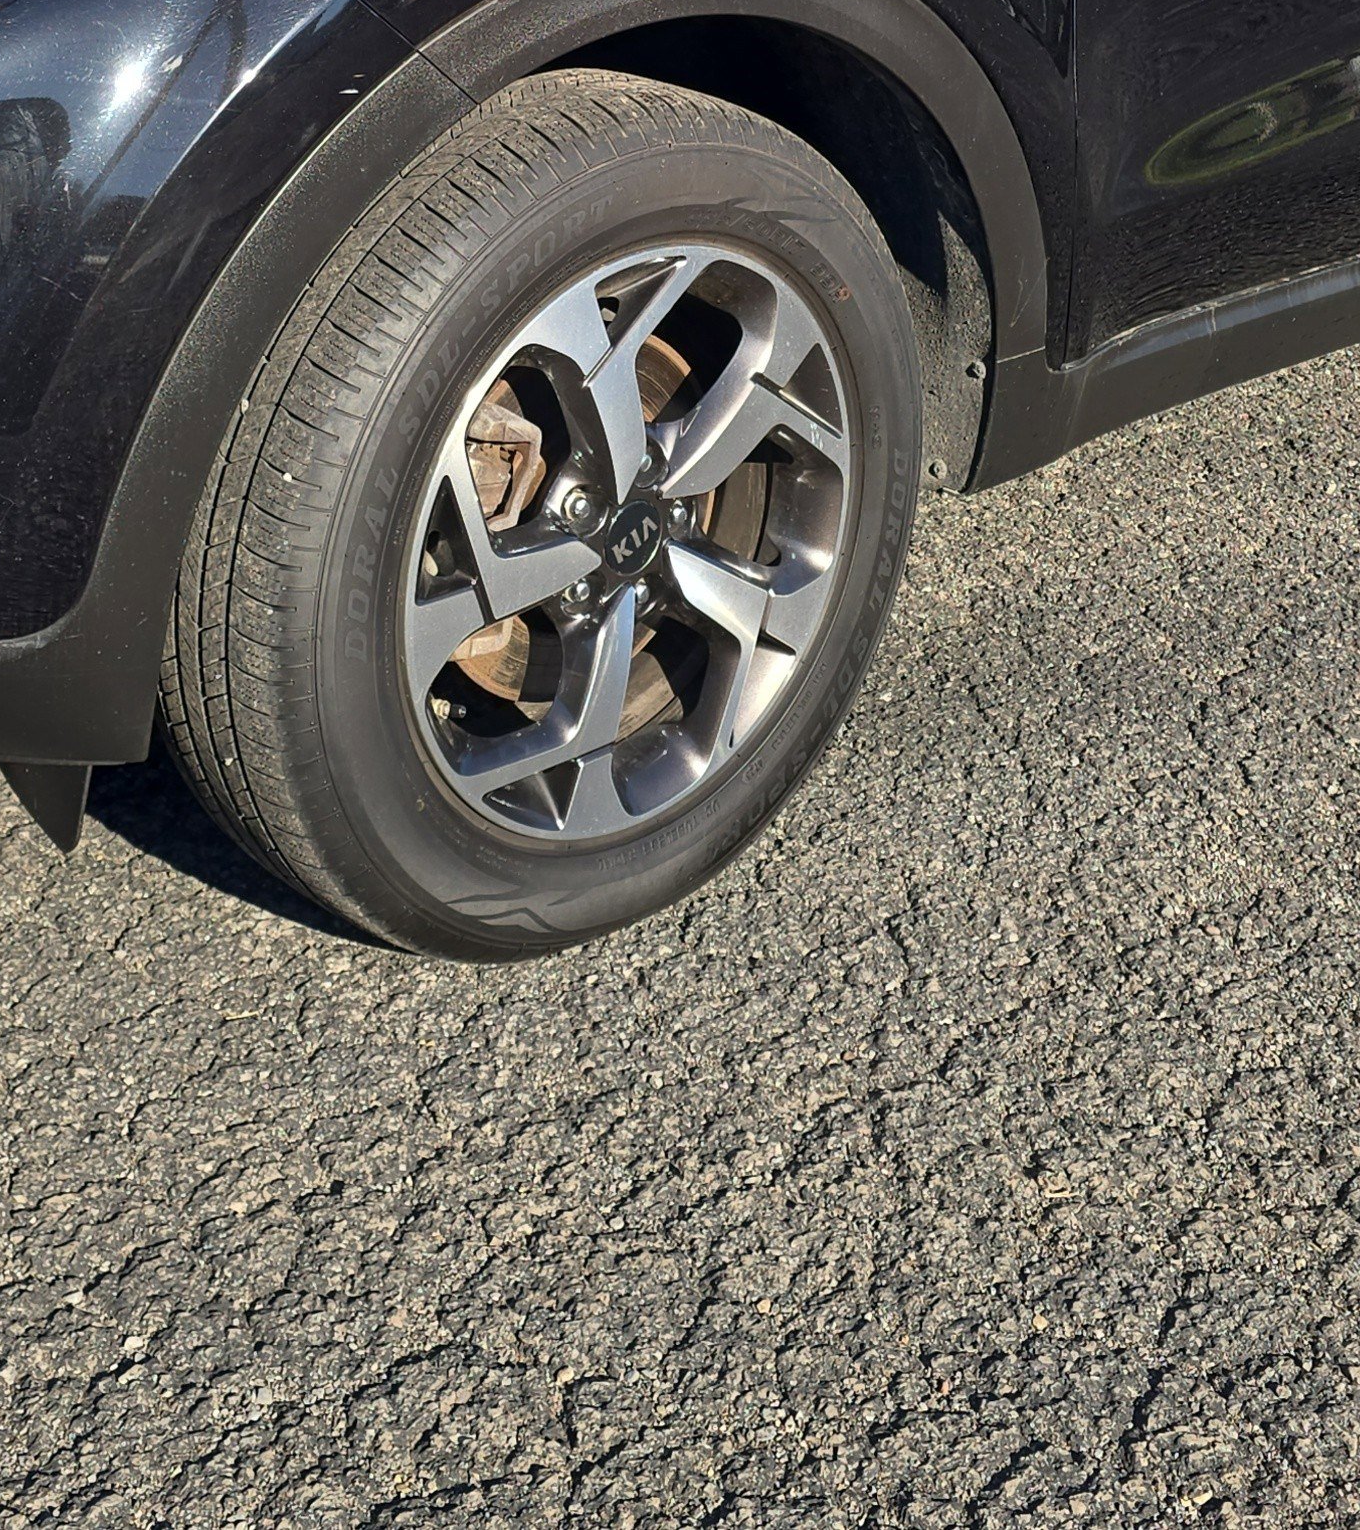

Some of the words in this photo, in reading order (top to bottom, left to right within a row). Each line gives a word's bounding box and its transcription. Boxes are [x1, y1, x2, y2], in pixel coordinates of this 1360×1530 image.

[345, 468, 400, 663] DORAL
[397, 194, 614, 450] SDL-SPORT
[611, 516, 658, 564] KIA
